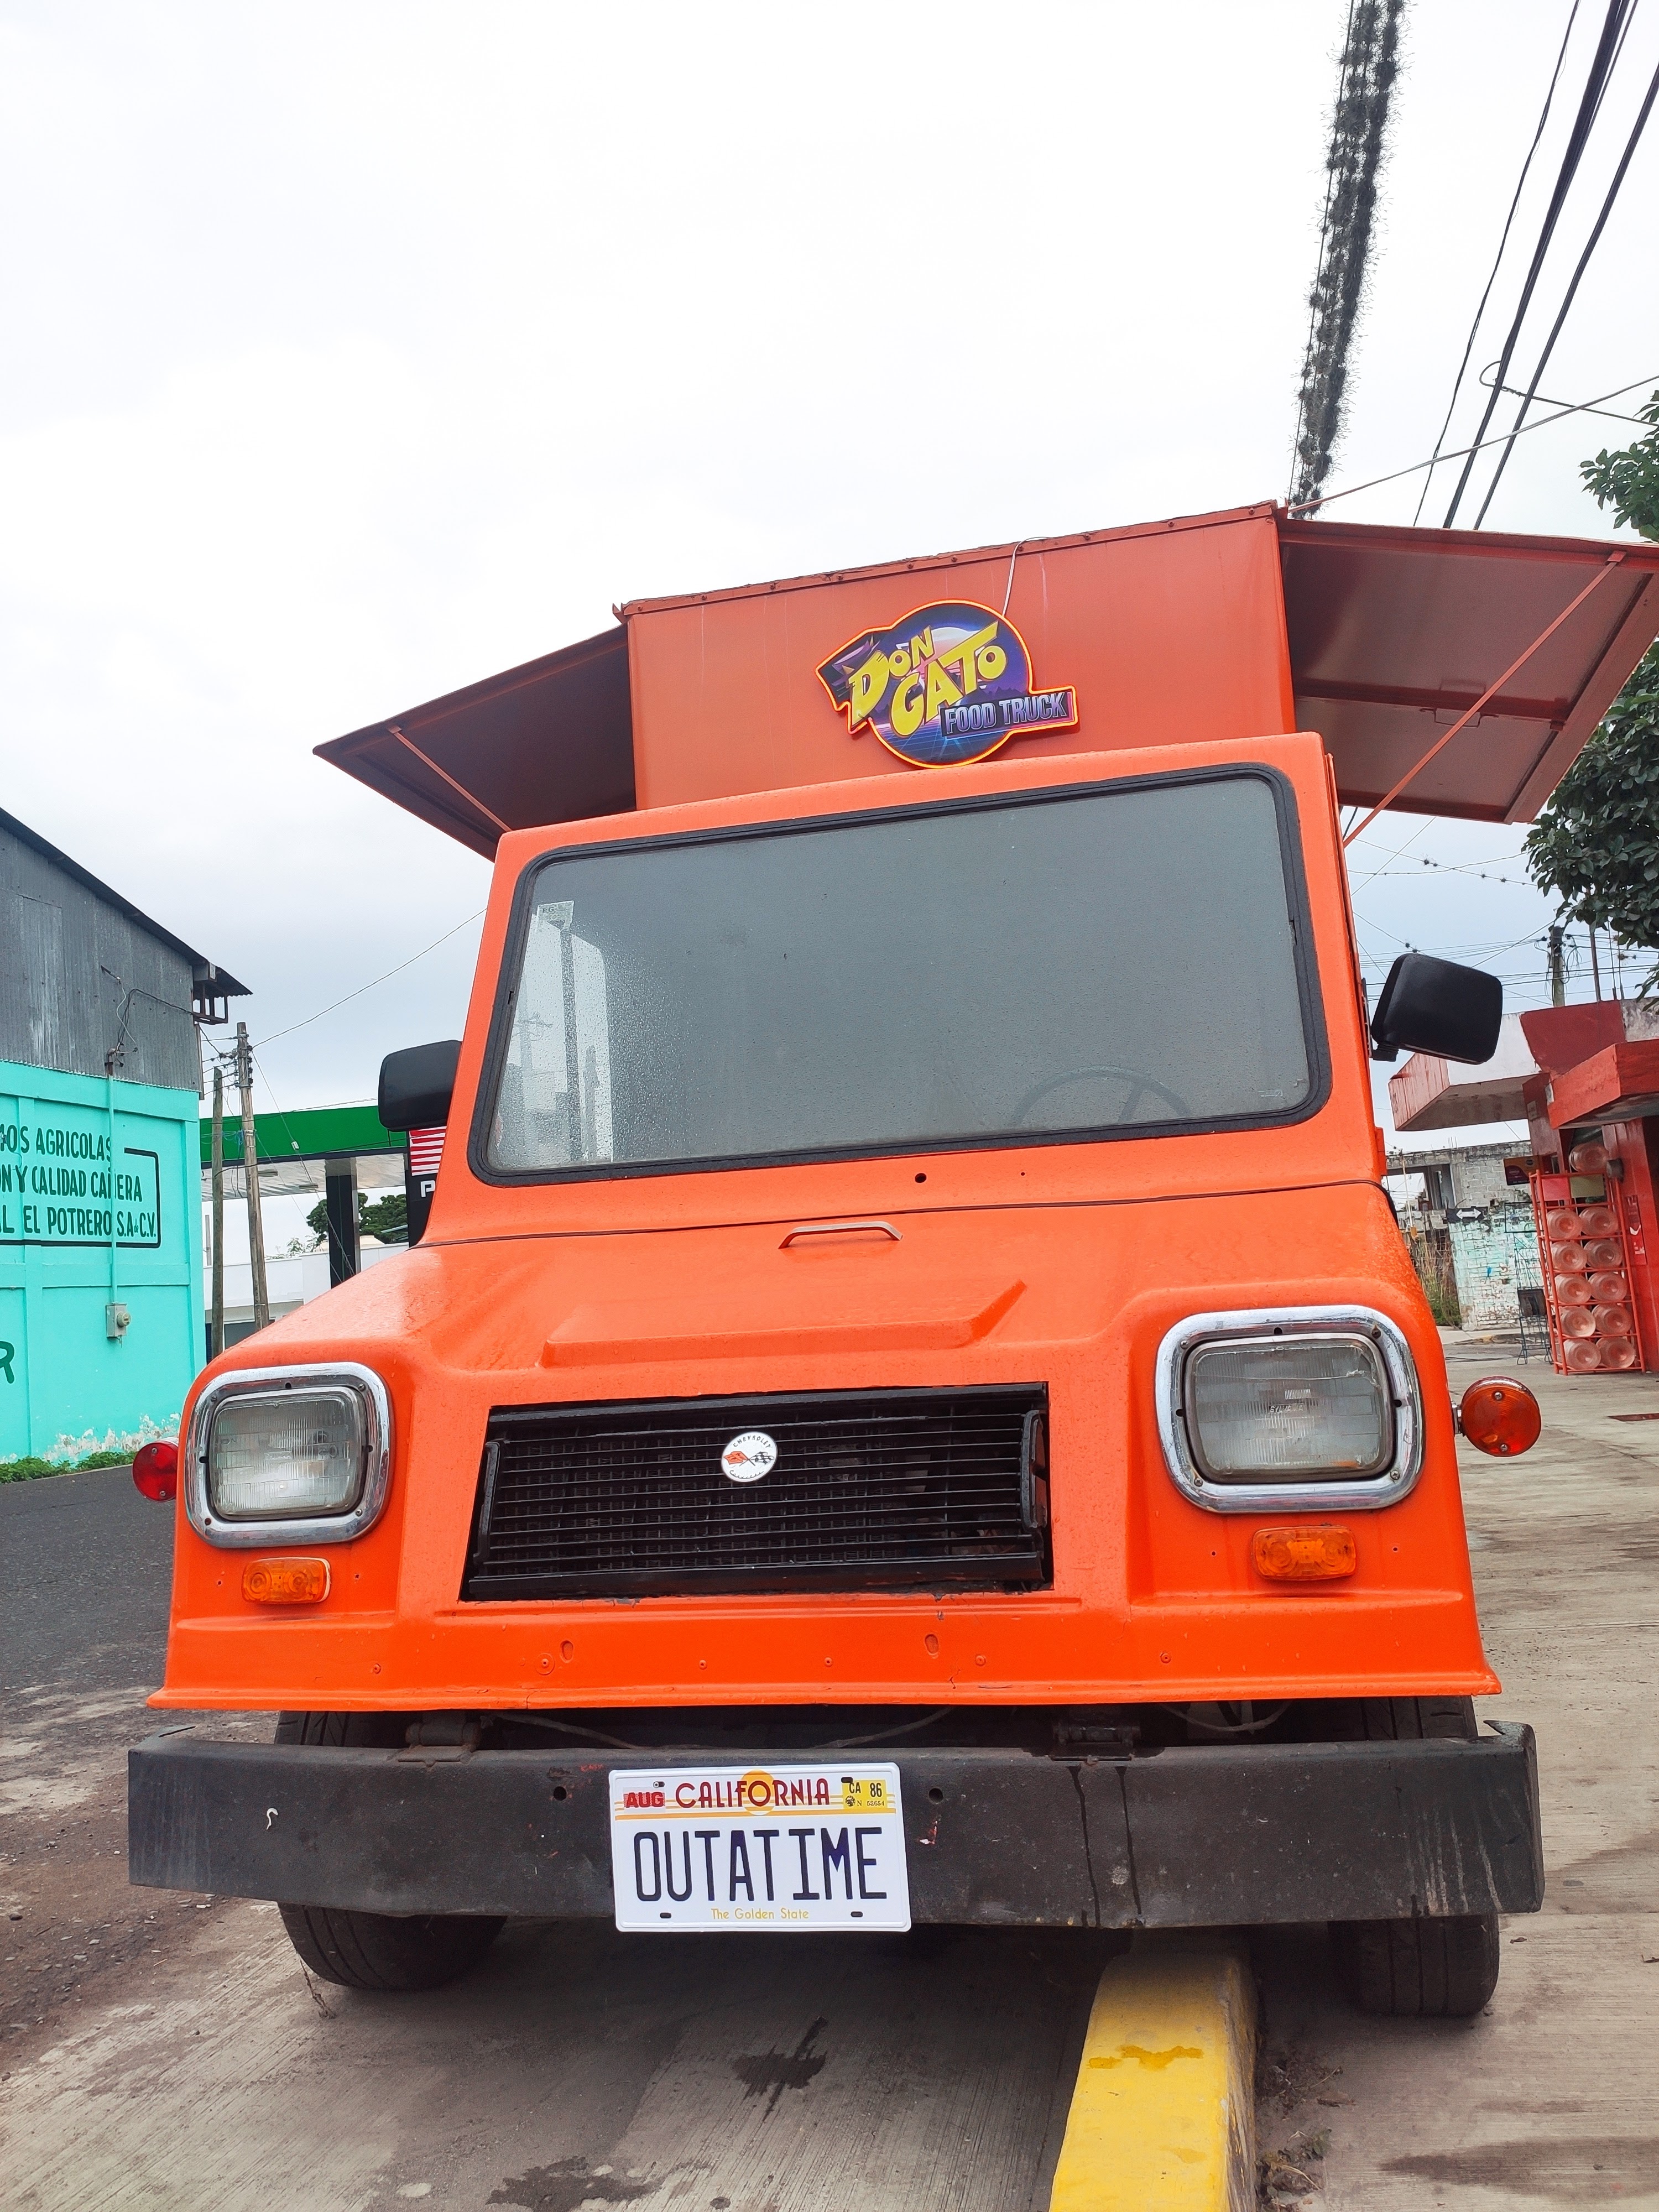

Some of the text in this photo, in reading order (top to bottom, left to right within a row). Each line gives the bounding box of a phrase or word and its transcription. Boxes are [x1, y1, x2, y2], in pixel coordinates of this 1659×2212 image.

[848, 625, 935, 729] DON
[890, 620, 1008, 737] GATO
[945, 692, 1067, 734] FOOD TRUCK
[36, 1128, 111, 1162] AGRICOLAS
[15, 1165, 28, 1193] Y
[32, 1166, 87, 1197] CALIDAD
[23, 1205, 41, 1234] EL
[47, 1207, 112, 1237] POTRERO
[733, 1435, 771, 1448] CHEVROLET
[625, 1792, 664, 1808] AUG
[675, 1778, 830, 1808] CALIFORNIA
[849, 1782, 883, 1798] CA 86
[633, 1827, 888, 1902] OUTATIME
[711, 1908, 810, 1920] The Golden State
